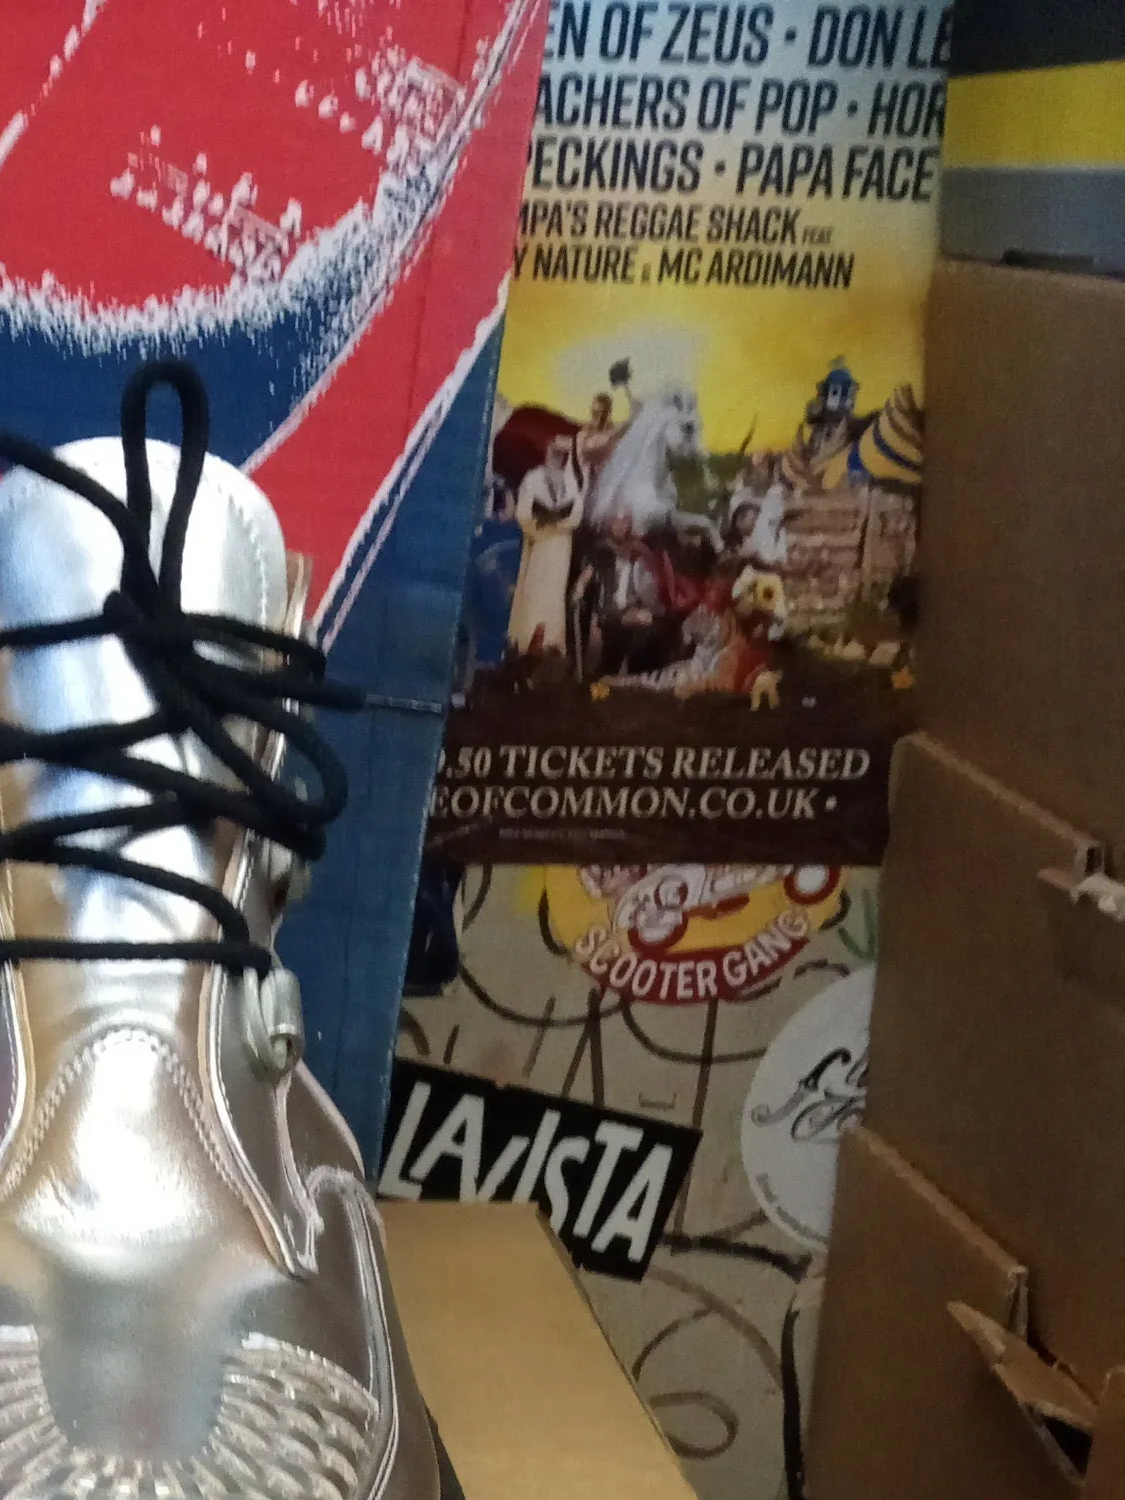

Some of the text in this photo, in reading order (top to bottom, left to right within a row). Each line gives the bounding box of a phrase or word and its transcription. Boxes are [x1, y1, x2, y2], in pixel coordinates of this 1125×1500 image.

[599, 1, 659, 63] OF
[660, 2, 776, 67] ZEUS
[807, 4, 905, 68] DON
[536, 72, 691, 132] ACHERS
[697, 76, 752, 136] OF
[755, 78, 839, 137] POP
[527, 135, 941, 204] ECKINGS PAPA FACE
[594, 201, 705, 244] REGGAE
[707, 205, 802, 246] SHACK
[532, 244, 639, 286] NATURE
[657, 247, 703, 287] MC
[705, 248, 855, 291] ARDIMANN
[499, 744, 665, 780] TICKETS
[672, 747, 871, 782] RELEASED
[574, 907, 810, 1001] SCOOTER GANG
